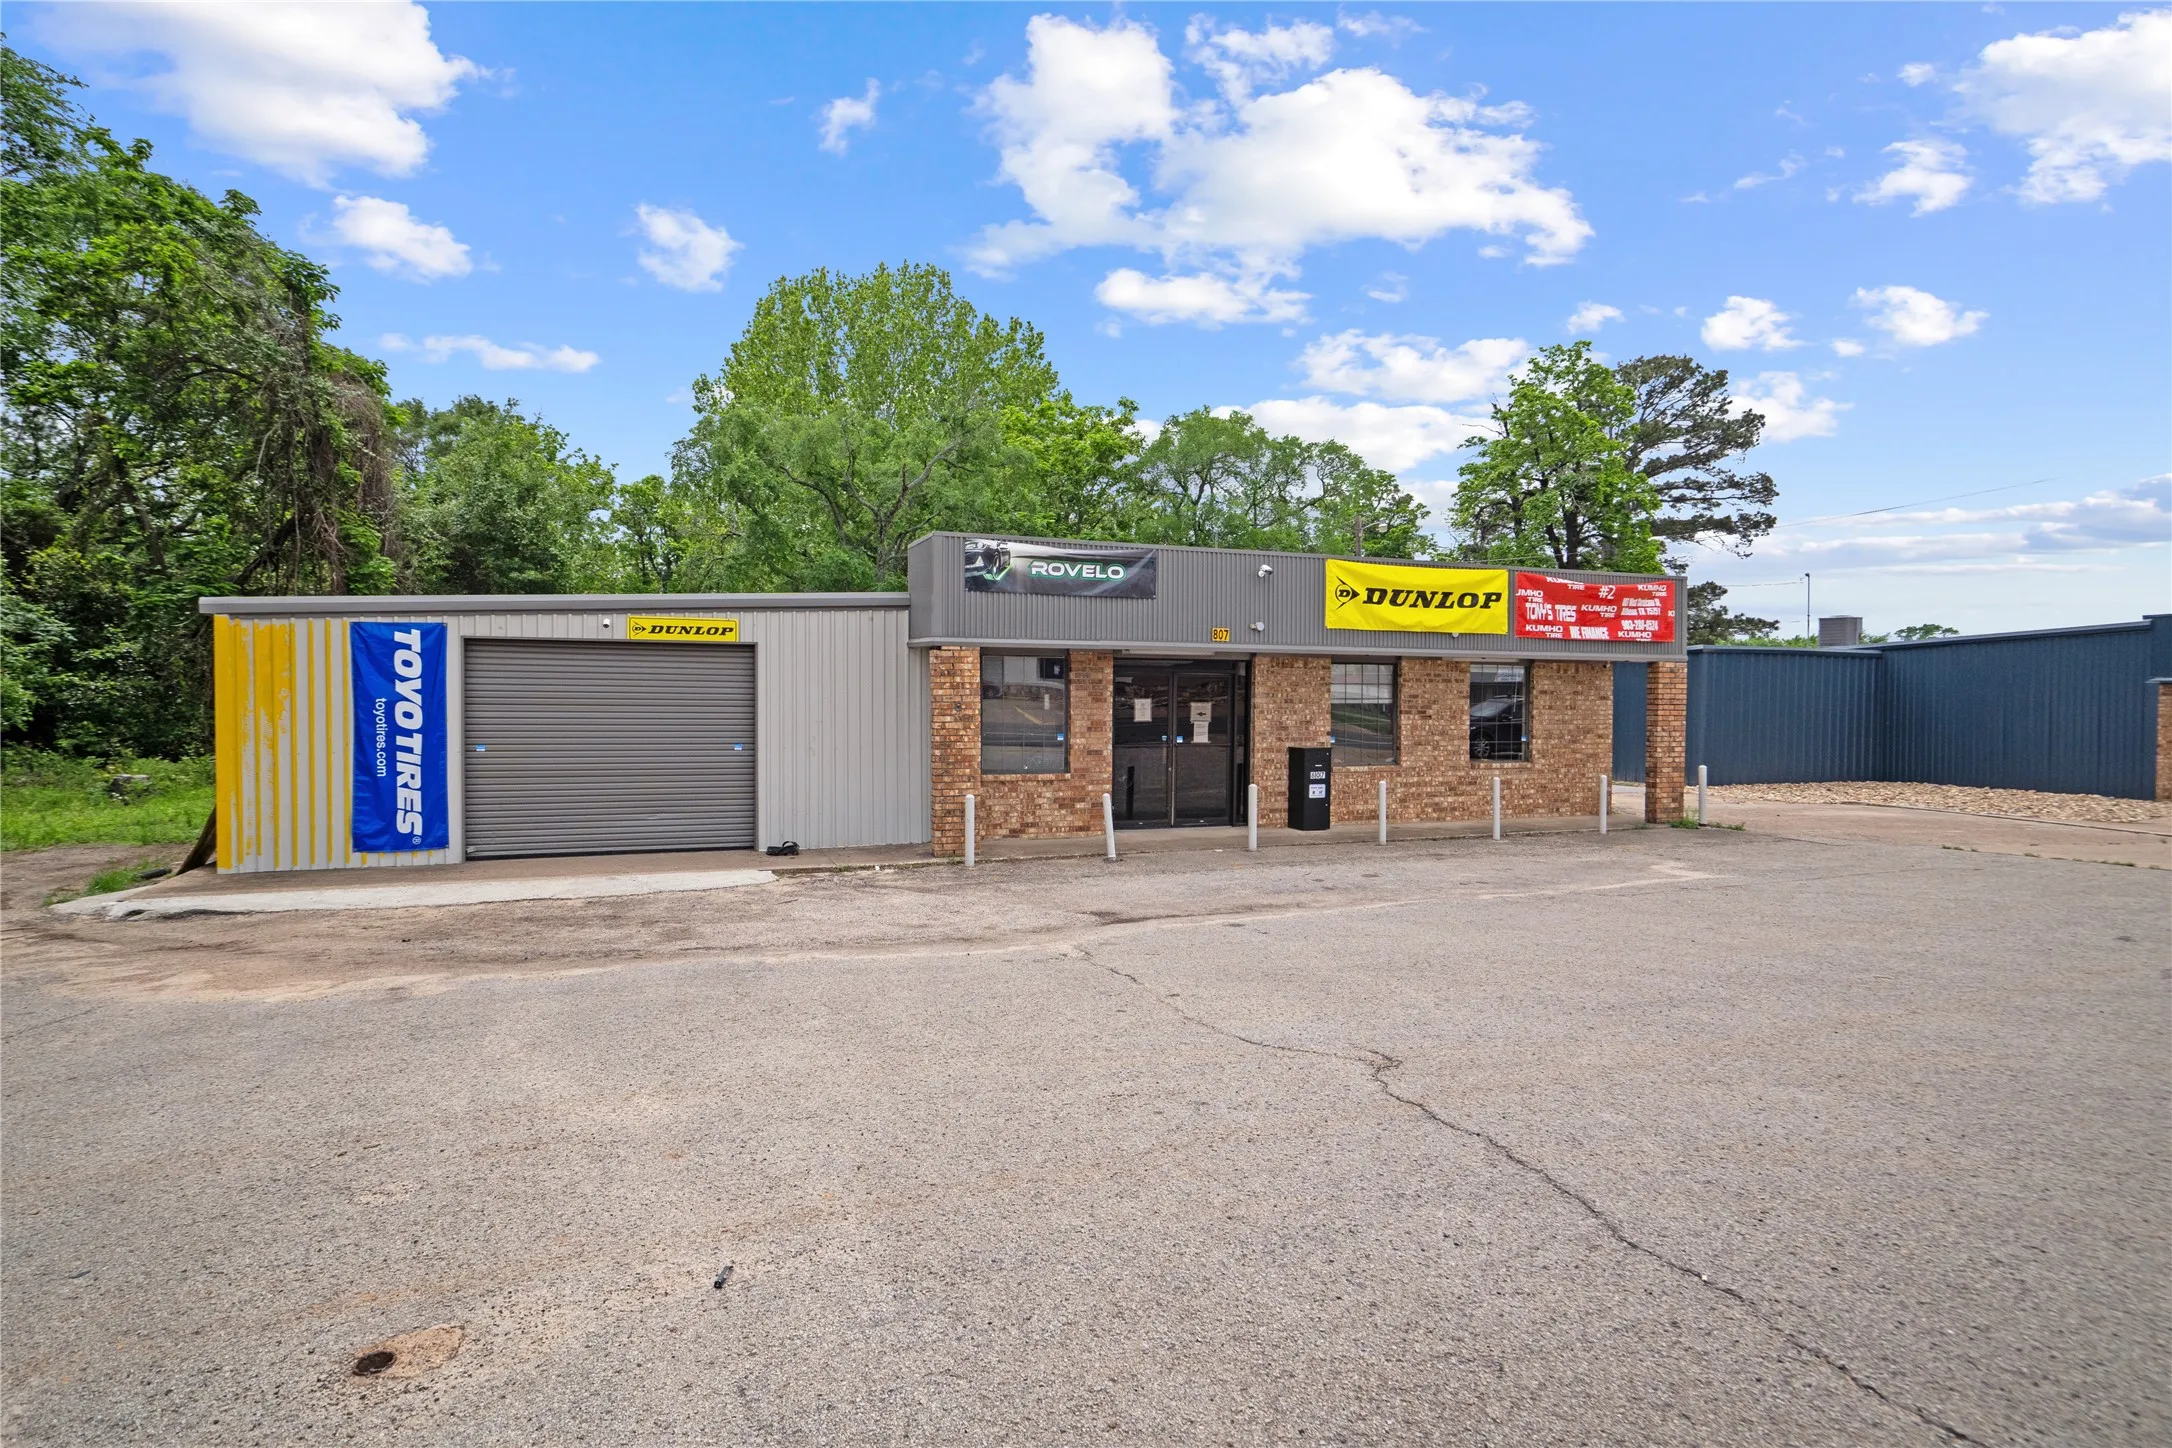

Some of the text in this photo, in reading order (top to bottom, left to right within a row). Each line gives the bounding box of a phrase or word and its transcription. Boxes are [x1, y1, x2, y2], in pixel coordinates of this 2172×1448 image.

[1031, 561, 1125, 579] ROVELO
[1362, 587, 1502, 609] DUNLOP
[1598, 585, 1616, 599] #2
[1525, 602, 1577, 622] TONY'S TIRES
[1581, 604, 1617, 612] KUMHO
[648, 625, 734, 636] DUNLOP
[1213, 629, 1229, 641] 807
[1525, 624, 1563, 633] KUMHO
[1581, 626, 1610, 640] FINANCE
[394, 628, 423, 730] TOYO
[373, 697, 388, 777] toyotires.com
